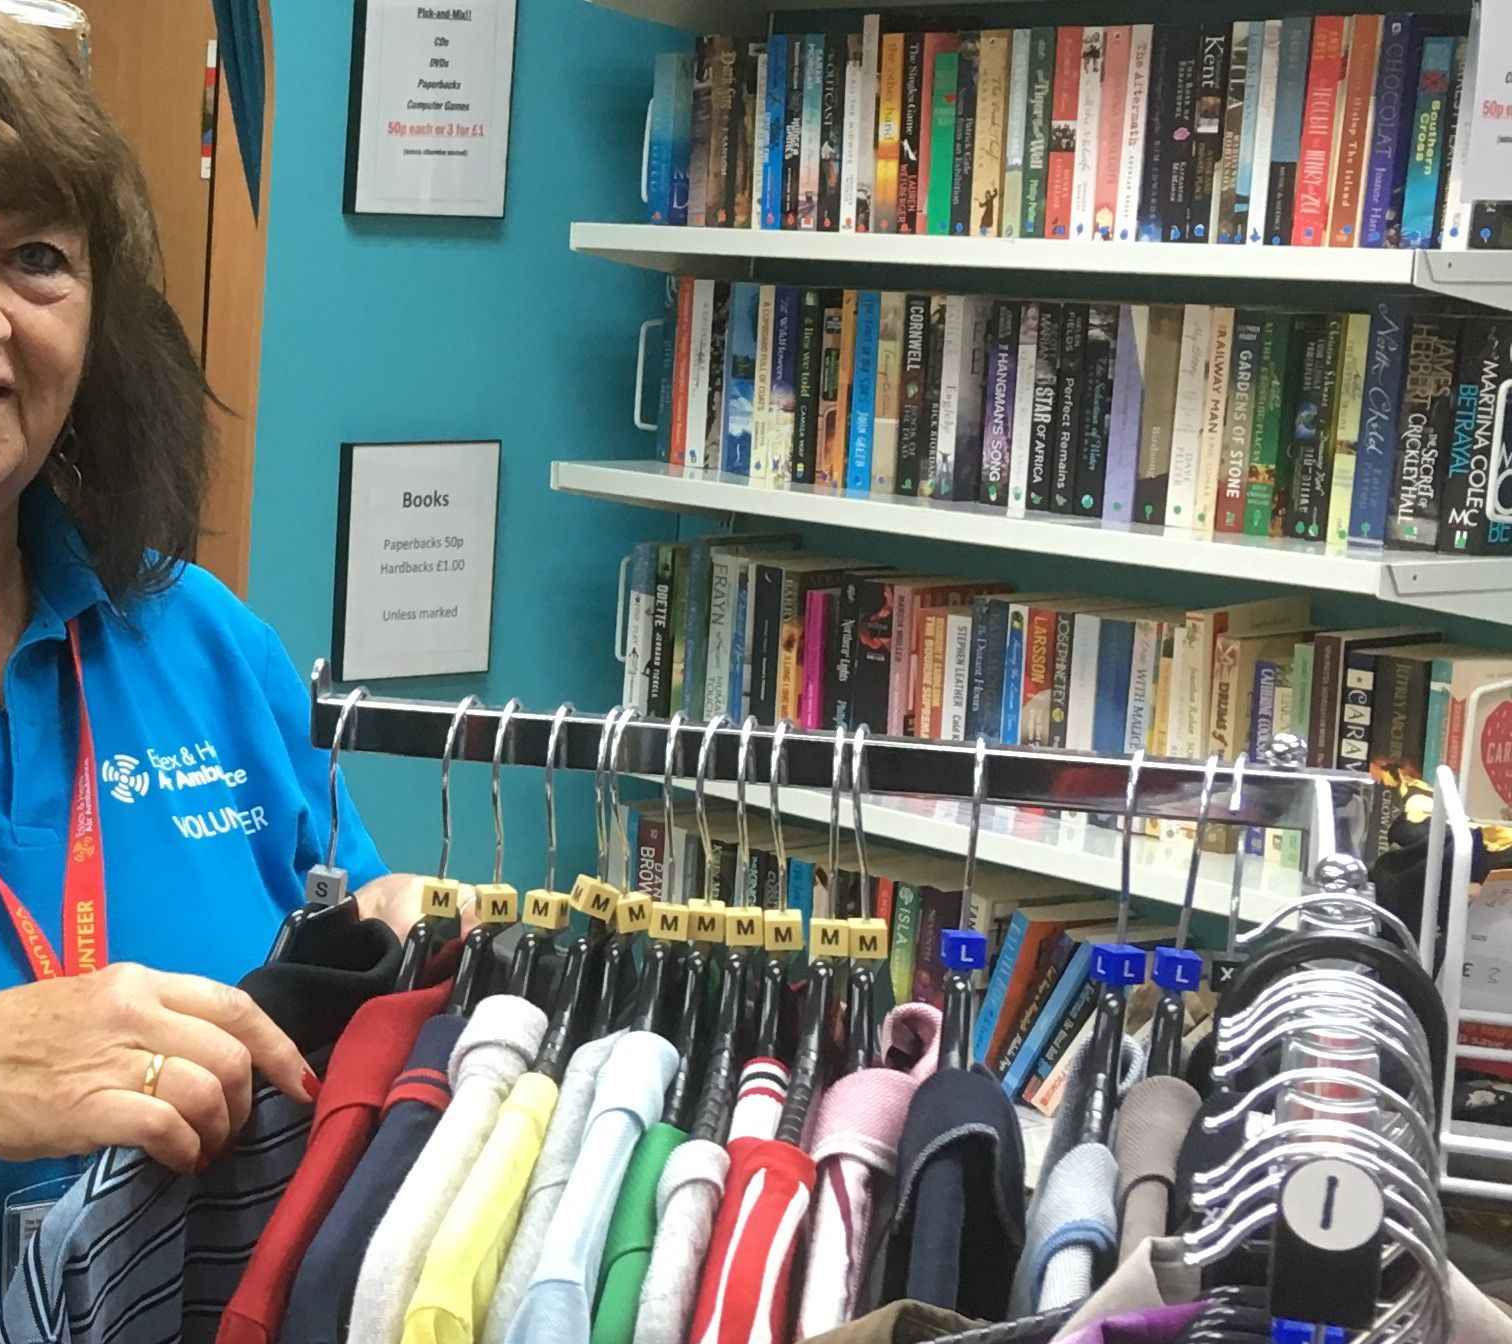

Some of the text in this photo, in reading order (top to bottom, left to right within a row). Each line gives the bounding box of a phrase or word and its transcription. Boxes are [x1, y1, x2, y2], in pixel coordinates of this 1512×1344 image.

[1202, 35, 1225, 89] Kent
[407, 99, 470, 112] Computer Games
[1129, 43, 1147, 146] The Aftermath
[1483, 100, 1503, 119] 50p
[387, 121, 485, 137] 50p each or 3 for £1
[883, 107, 895, 141] hand
[1372, 43, 1403, 204] CHOCOLAT Joanne
[1416, 113, 1429, 162] Cross
[1424, 99, 1441, 175] Southern
[1341, 141, 1358, 207] The Island
[907, 306, 924, 372] CORNWELL
[800, 327, 813, 397] lies we told
[1207, 329, 1226, 433] RAILWAY MAN
[1404, 325, 1439, 410] HERBERT
[1431, 340, 1456, 397] JAMES
[989, 353, 1009, 482] HANGMAN'S SONG
[1032, 387, 1055, 483] STAR OF AFRICA
[1056, 378, 1075, 489] Perfect Remains
[1226, 350, 1253, 498] GARDENS OF STONE
[1366, 387, 1390, 456] Child
[1448, 384, 1479, 478] BETRAYAL
[1465, 360, 1499, 508] MARTINA COLE
[1145, 426, 1160, 479] Birdsong
[1397, 413, 1427, 525] CRICKLEY HALL
[1415, 448, 1438, 499] SECRET
[402, 490, 450, 508] Books
[384, 536, 464, 550] Paperbacks 50p
[381, 559, 465, 575] Hardbacks £1.00
[383, 606, 458, 621] Unless marked
[655, 584, 668, 628] ODETTE
[711, 563, 729, 626] FRAYN
[1031, 615, 1047, 683] LARSSON
[952, 625, 967, 733] STEPHEN LEATHER Cold
[1053, 684, 1066, 705] TEY
[1129, 669, 1147, 751] WITH MALICE
[1215, 681, 1230, 729] DRUMS
[180, 746, 197, 766] &
[315, 882, 329, 899] S
[432, 889, 450, 907] M
[491, 900, 509, 916] M
[532, 899, 548, 916] M
[592, 895, 610, 912] M
[629, 904, 646, 922] M
[661, 915, 678, 931] M
[698, 916, 715, 931] M
[737, 919, 754, 935] M
[775, 927, 792, 942] M
[821, 928, 839, 945] M
[860, 935, 877, 951] M
[961, 945, 974, 962] L
[1097, 957, 1106, 974] L
[1123, 960, 1135, 978] L
[1175, 965, 1189, 983] L
